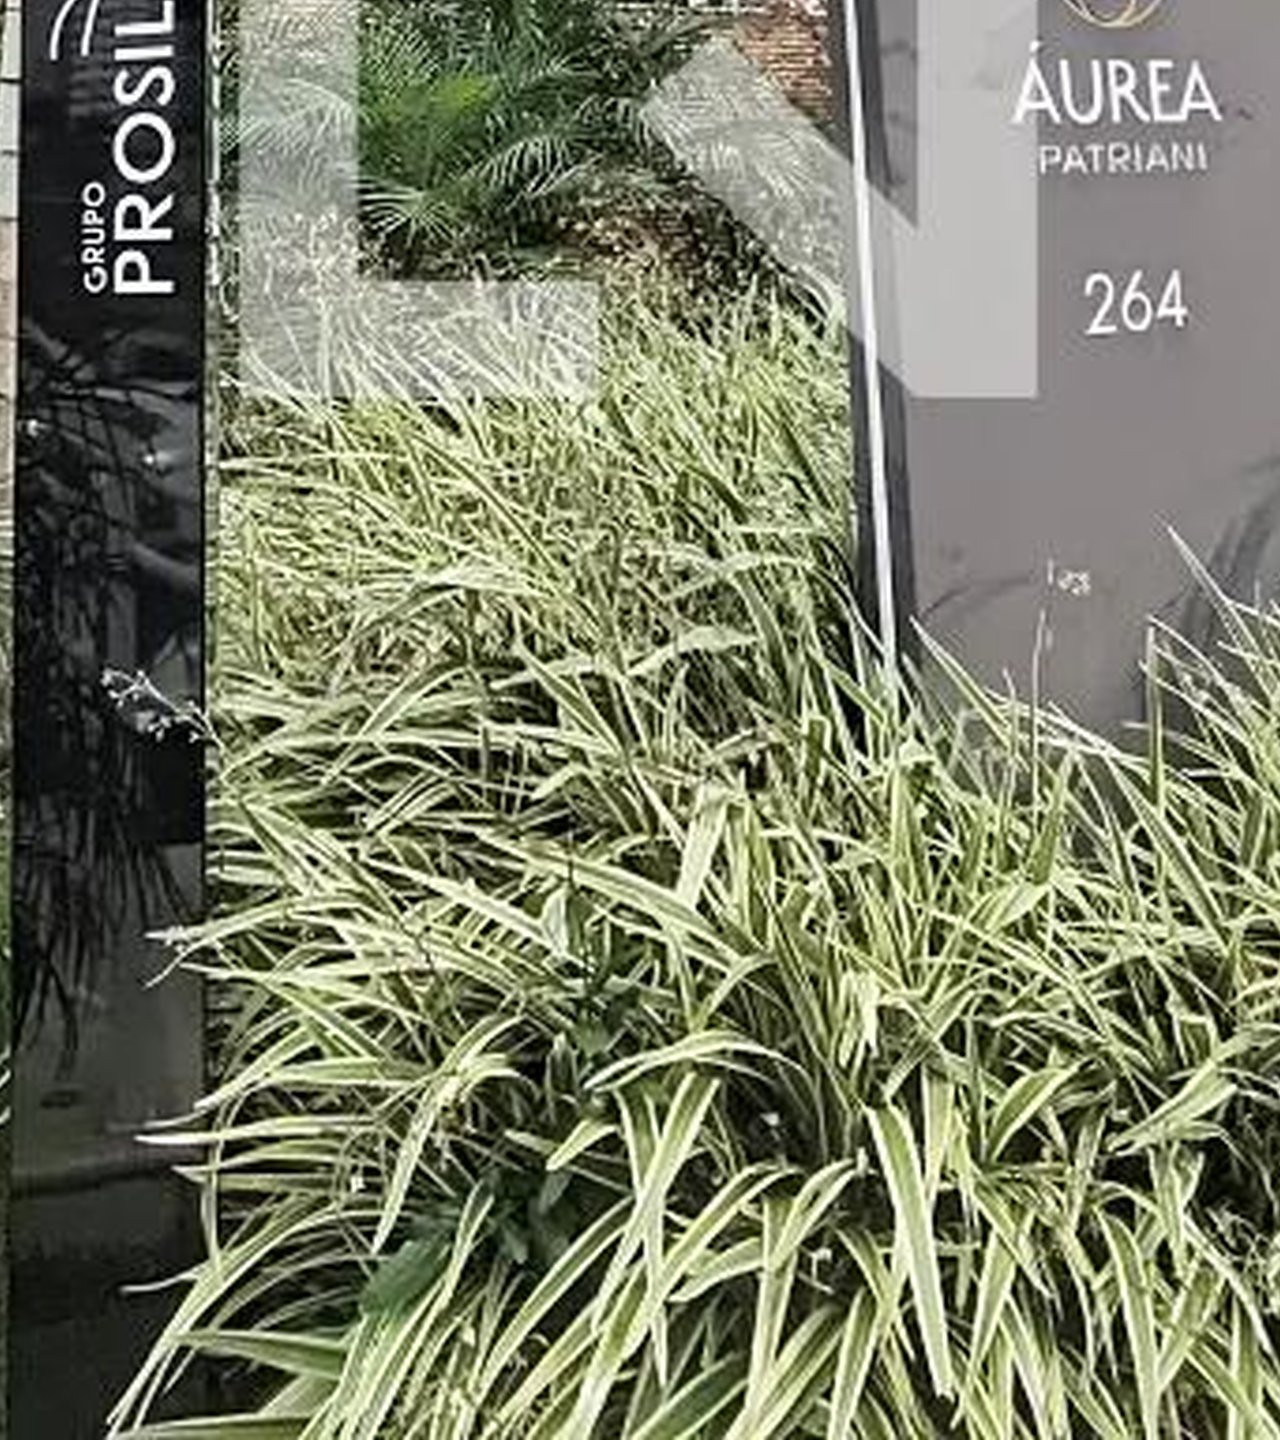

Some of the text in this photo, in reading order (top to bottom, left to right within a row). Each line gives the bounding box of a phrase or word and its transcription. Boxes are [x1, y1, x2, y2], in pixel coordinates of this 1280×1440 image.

[1010, 40, 1222, 125] ÁUREA
[113, 0, 176, 295] PROSIL
[1038, 142, 1208, 174] PATRIANI
[81, 181, 108, 294] GRUPO
[1084, 269, 1189, 335] 264
